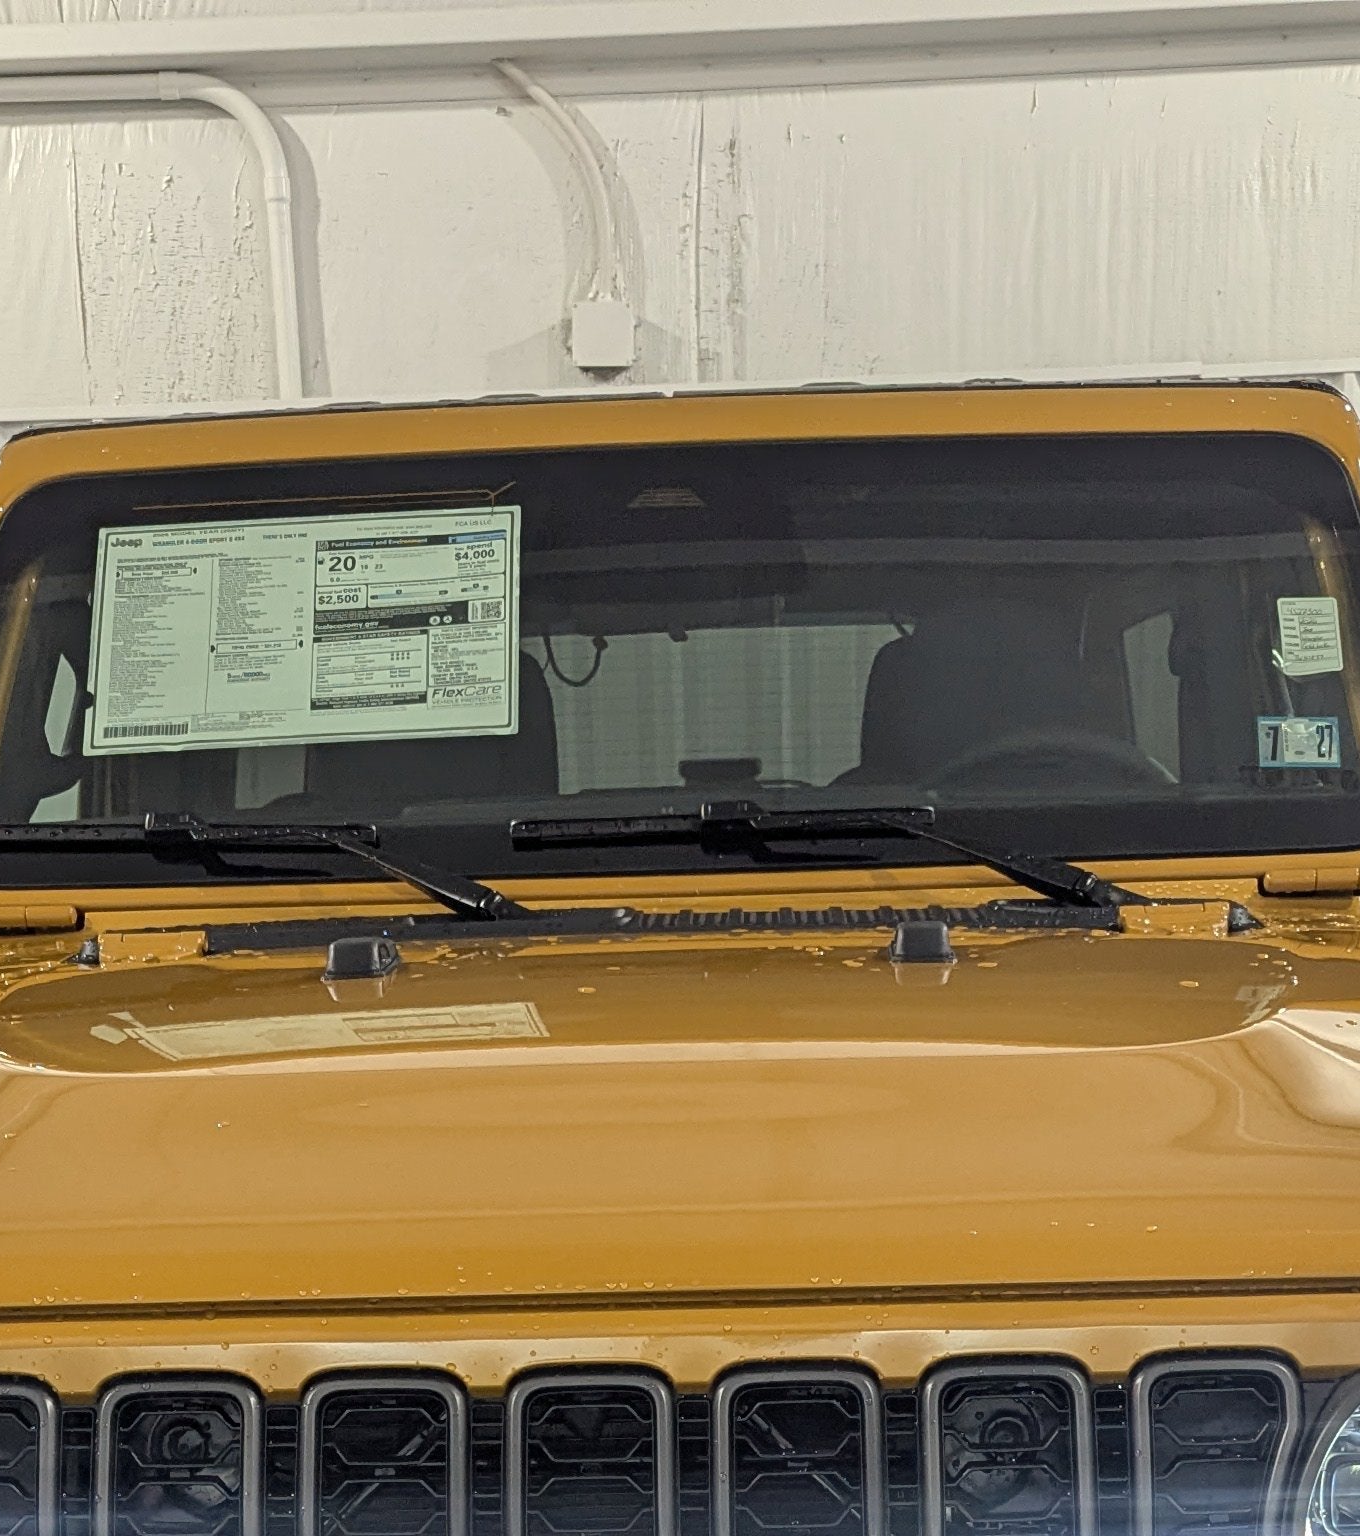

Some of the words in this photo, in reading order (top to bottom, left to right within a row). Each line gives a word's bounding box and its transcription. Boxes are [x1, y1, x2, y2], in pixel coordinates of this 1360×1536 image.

[110, 537, 143, 548] Jeep
[467, 541, 493, 550] spend
[454, 548, 496, 561] $4,000
[328, 555, 356, 572] 20
[318, 594, 359, 605] $2,500
[431, 684, 502, 699] FlexCare
[1267, 726, 1279, 761] 7
[1315, 724, 1333, 761] 27
